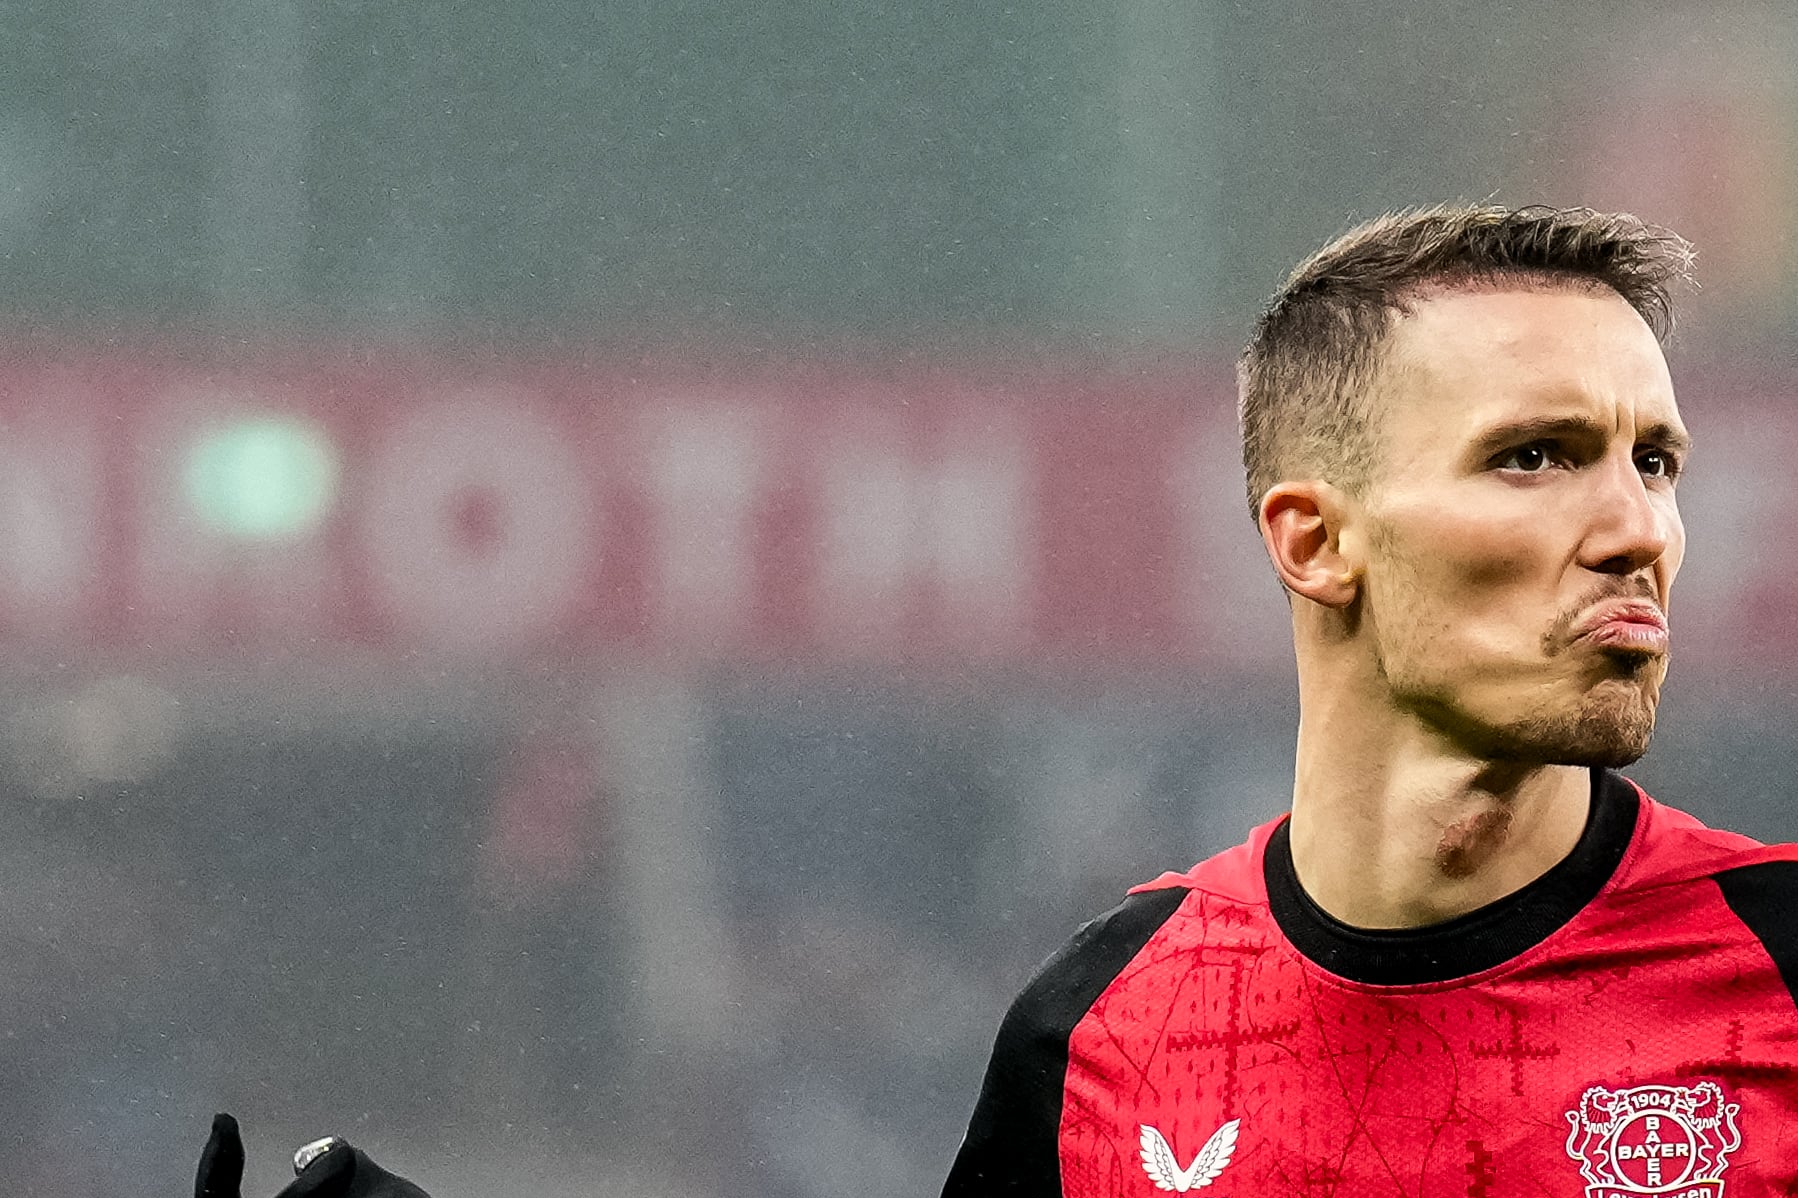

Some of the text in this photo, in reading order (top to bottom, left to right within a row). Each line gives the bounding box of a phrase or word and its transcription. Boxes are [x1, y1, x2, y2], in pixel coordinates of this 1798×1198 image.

[1630, 1091, 1672, 1110] 1904
[1617, 1142, 1690, 1161] BAYER
[1644, 1116, 1662, 1187] BAYER
